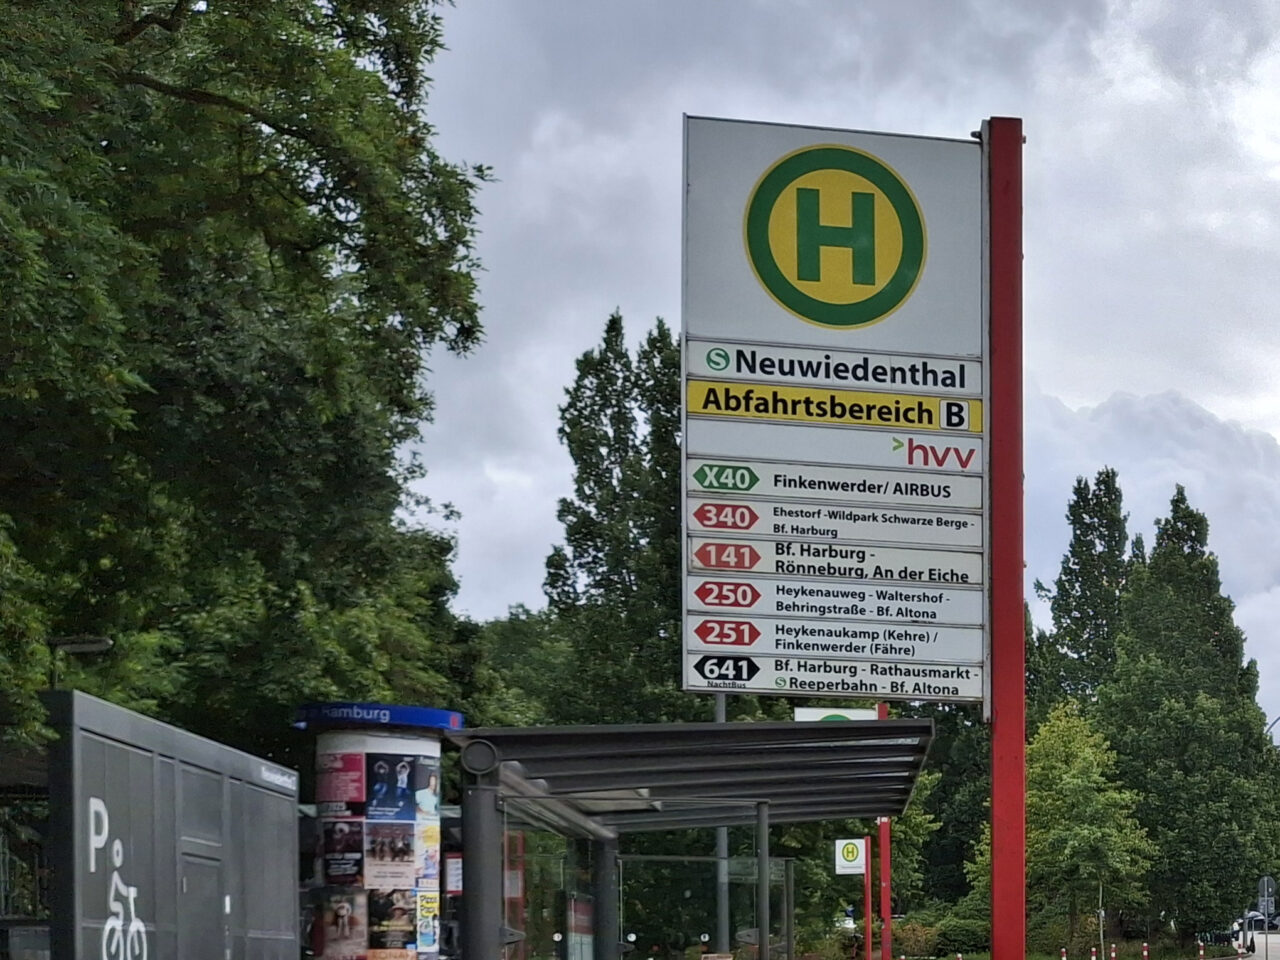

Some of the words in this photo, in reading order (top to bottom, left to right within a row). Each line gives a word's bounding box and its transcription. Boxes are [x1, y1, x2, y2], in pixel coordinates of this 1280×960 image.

[796, 188, 876, 286] H
[736, 349, 965, 389] Neuwiedenthal
[702, 387, 933, 425] Abfahrtsbereich
[946, 402, 965, 428] B
[908, 438, 976, 469] hvv
[702, 466, 750, 489] X40
[773, 474, 889, 495] Finkenwerder/
[893, 482, 952, 498] AIRBUS
[703, 505, 751, 527] 340
[773, 507, 821, 519] Ehestorf
[881, 513, 934, 526] Schwarze
[936, 517, 969, 530] Berge
[773, 524, 788, 534] Bf.
[791, 525, 838, 539] Harburg
[706, 545, 751, 567] 141
[775, 542, 796, 556] Bf.
[800, 544, 866, 563] Harburg
[775, 560, 869, 580] Rönneburg,
[873, 566, 894, 578] An
[898, 567, 924, 581] der
[928, 568, 969, 583] Eiche
[704, 583, 751, 605] 250
[776, 585, 866, 602] Heykenauweg
[876, 590, 944, 604] Waltershof
[776, 601, 867, 616] Behringstraße
[877, 607, 893, 617] Bf.
[896, 607, 937, 620] Altona
[706, 622, 751, 643] 251
[775, 624, 880, 641] Heykenaukamp
[883, 629, 930, 643] (Kehre)
[775, 639, 867, 653] Finkenwerder
[870, 643, 916, 657] (Fähre)
[703, 658, 748, 679] 641
[774, 659, 793, 672] Bf.
[797, 661, 858, 678] Harburg
[870, 664, 971, 680] Rathausmarkt
[707, 681, 746, 689] NachtBus
[789, 677, 878, 692] Reeperbahn
[890, 681, 909, 694] Bf.
[912, 682, 960, 695] Altona
[89, 796, 109, 873] P
